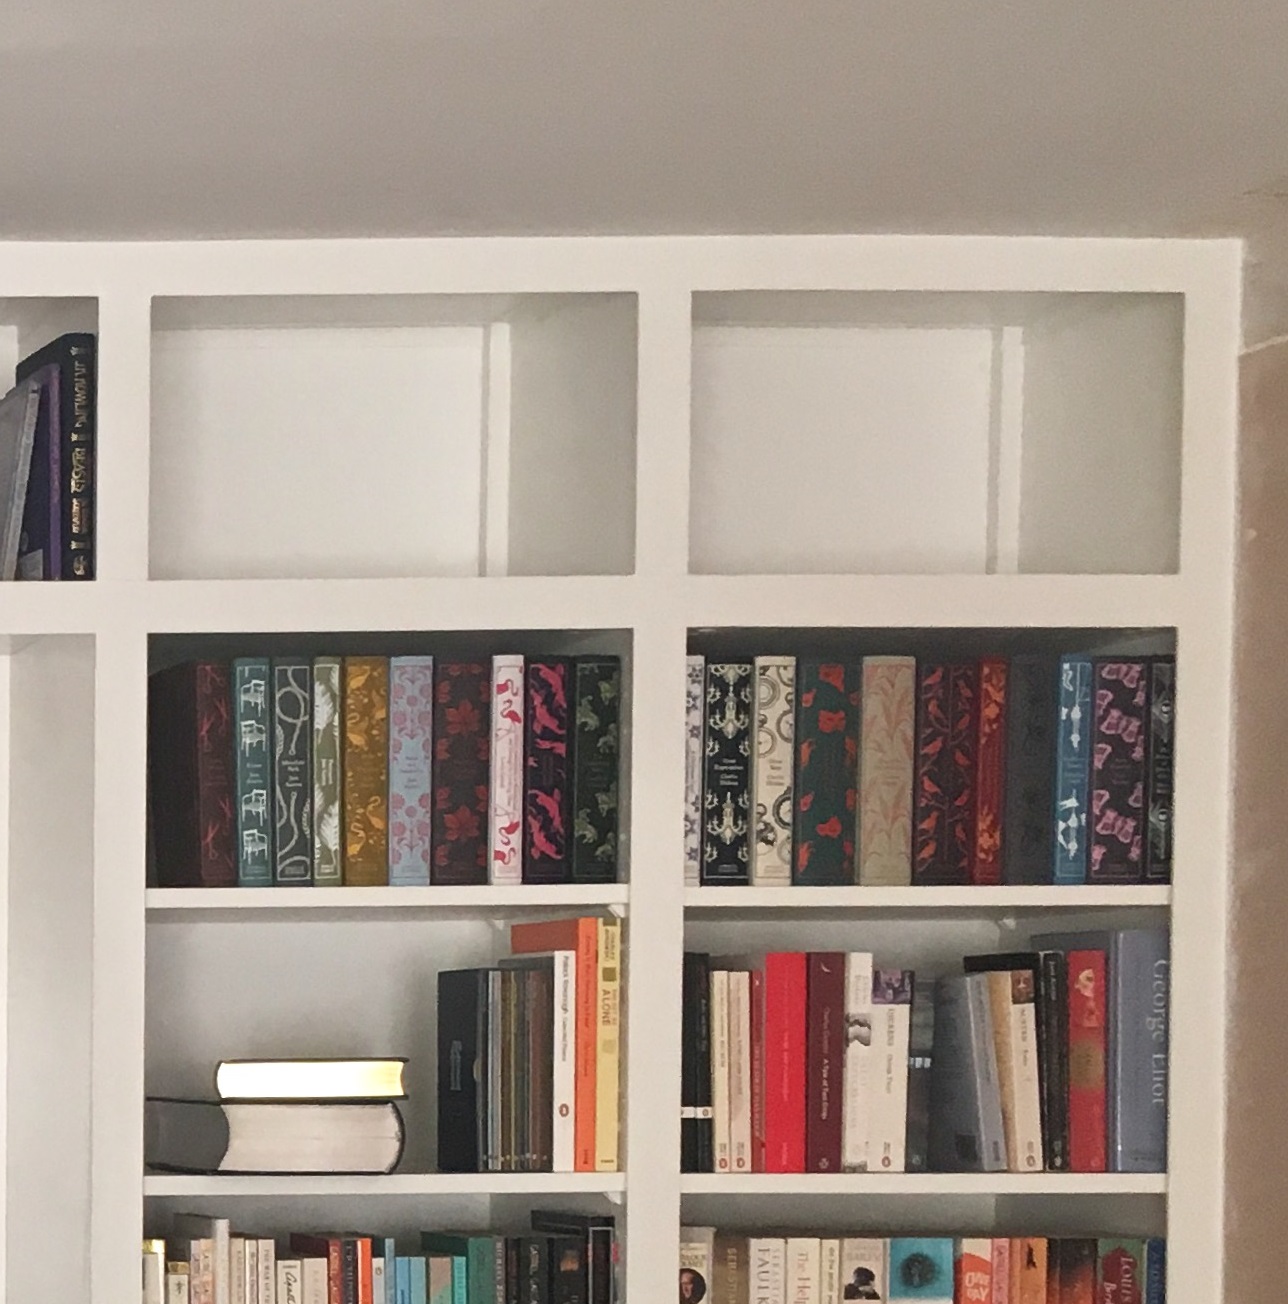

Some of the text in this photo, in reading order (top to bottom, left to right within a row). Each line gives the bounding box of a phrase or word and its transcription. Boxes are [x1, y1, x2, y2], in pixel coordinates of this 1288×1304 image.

[601, 989, 611, 1026] ALONE
[1146, 959, 1167, 1105] George Eliot
[797, 1252, 808, 1272] The
[1120, 1258, 1133, 1304] LOUIS
